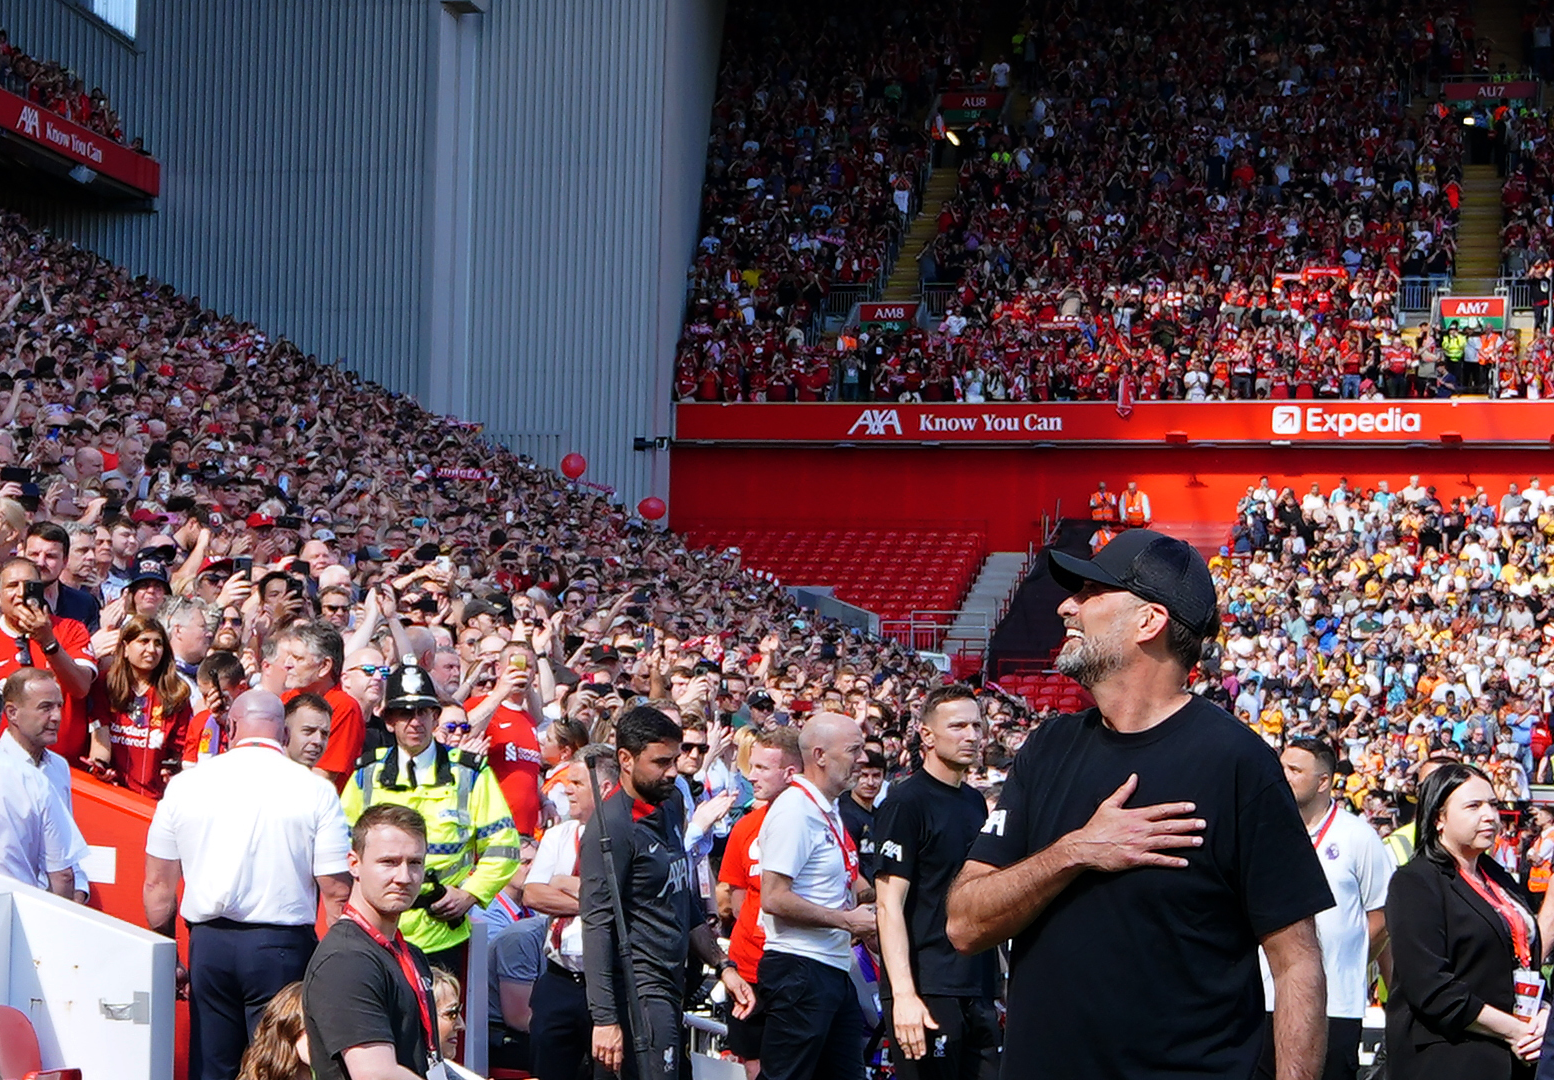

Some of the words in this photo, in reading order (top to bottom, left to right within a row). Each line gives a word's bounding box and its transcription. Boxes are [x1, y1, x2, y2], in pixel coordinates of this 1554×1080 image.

[1478, 86, 1505, 97] AU7
[962, 97, 986, 107] AU8
[16, 106, 40, 138] AXA
[46, 122, 70, 150] Know
[70, 134, 87, 155] You
[86, 142, 103, 163] Can
[874, 308, 904, 319] AM8
[1456, 302, 1489, 314] AM7
[847, 409, 902, 435] AXA
[919, 414, 977, 431] Know
[982, 414, 1019, 431] You
[1023, 414, 1063, 431] Can
[1306, 407, 1421, 437] Expedia
[110, 722, 149, 738] tandard
[110, 735, 148, 748] artered
